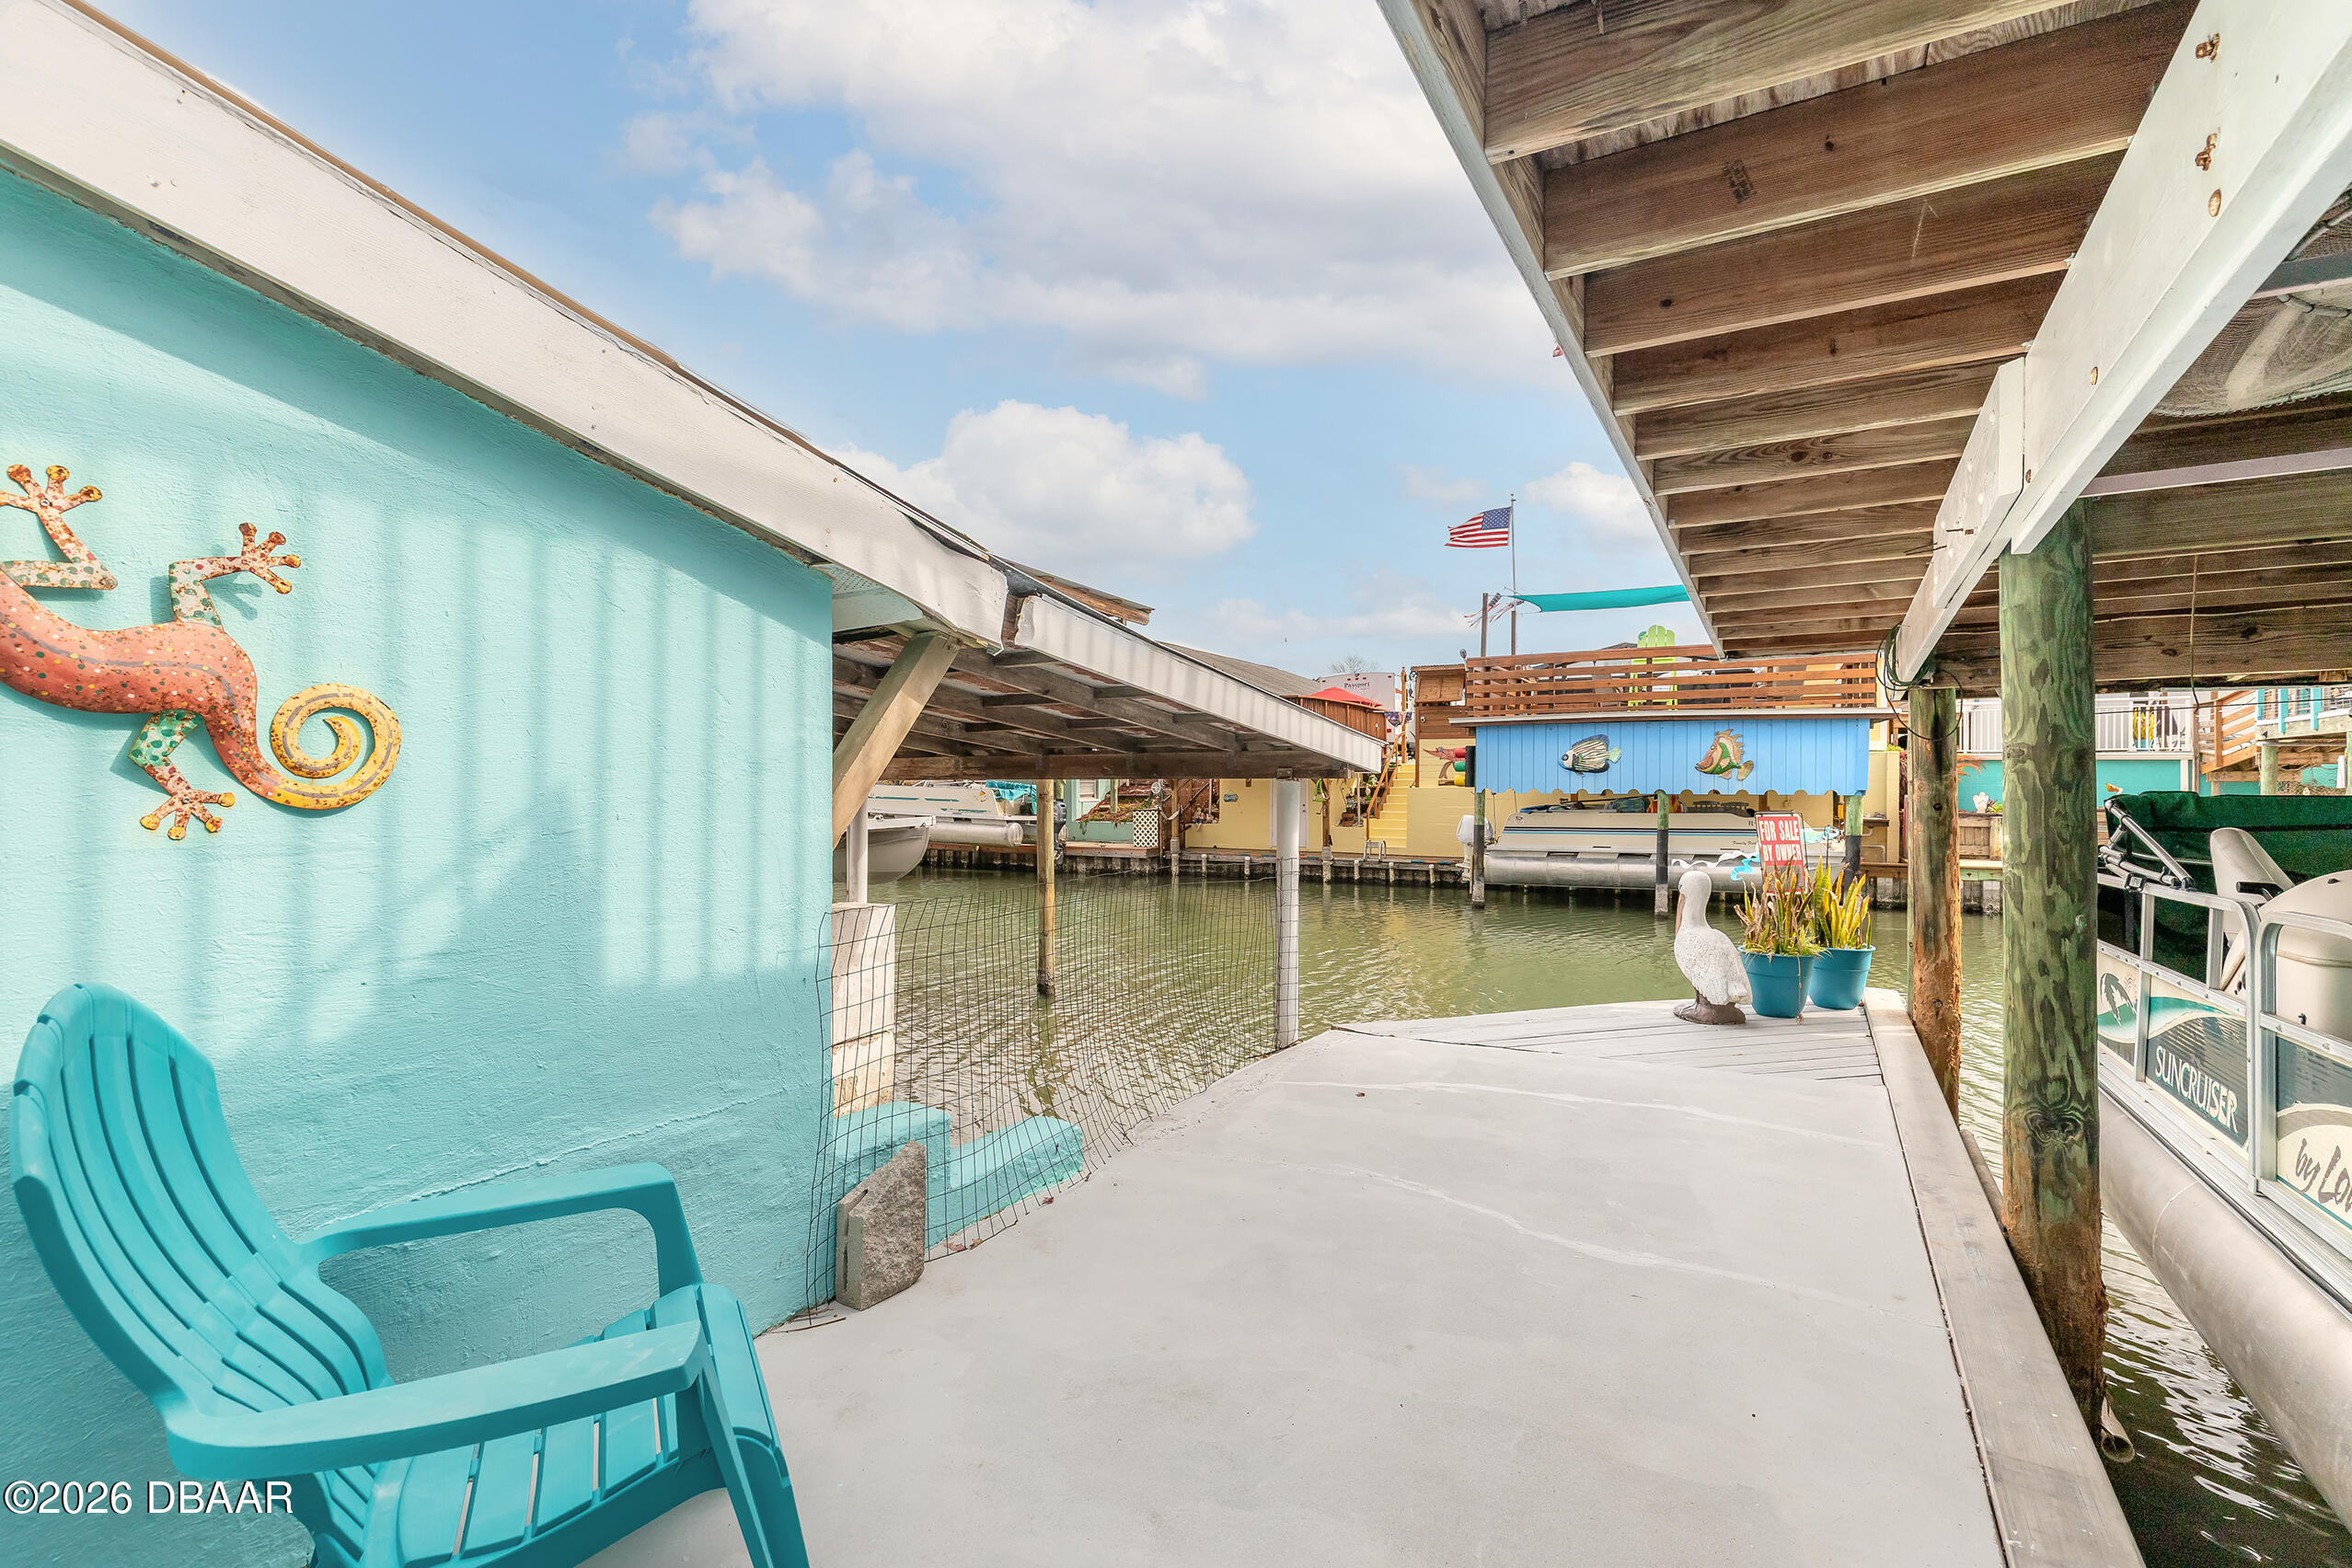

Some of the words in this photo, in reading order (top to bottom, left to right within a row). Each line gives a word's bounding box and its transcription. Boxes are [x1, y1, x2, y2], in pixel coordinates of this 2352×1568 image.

[1758, 820, 1777, 841] FOR
[1779, 820, 1800, 841] SALE
[1762, 844, 1773, 861] BY
[1775, 844, 1803, 861] OWNER
[2154, 1045, 2239, 1134] SUNCRUISER
[2295, 1137, 2321, 1193] by
[2318, 1145, 2352, 1213] Lo
